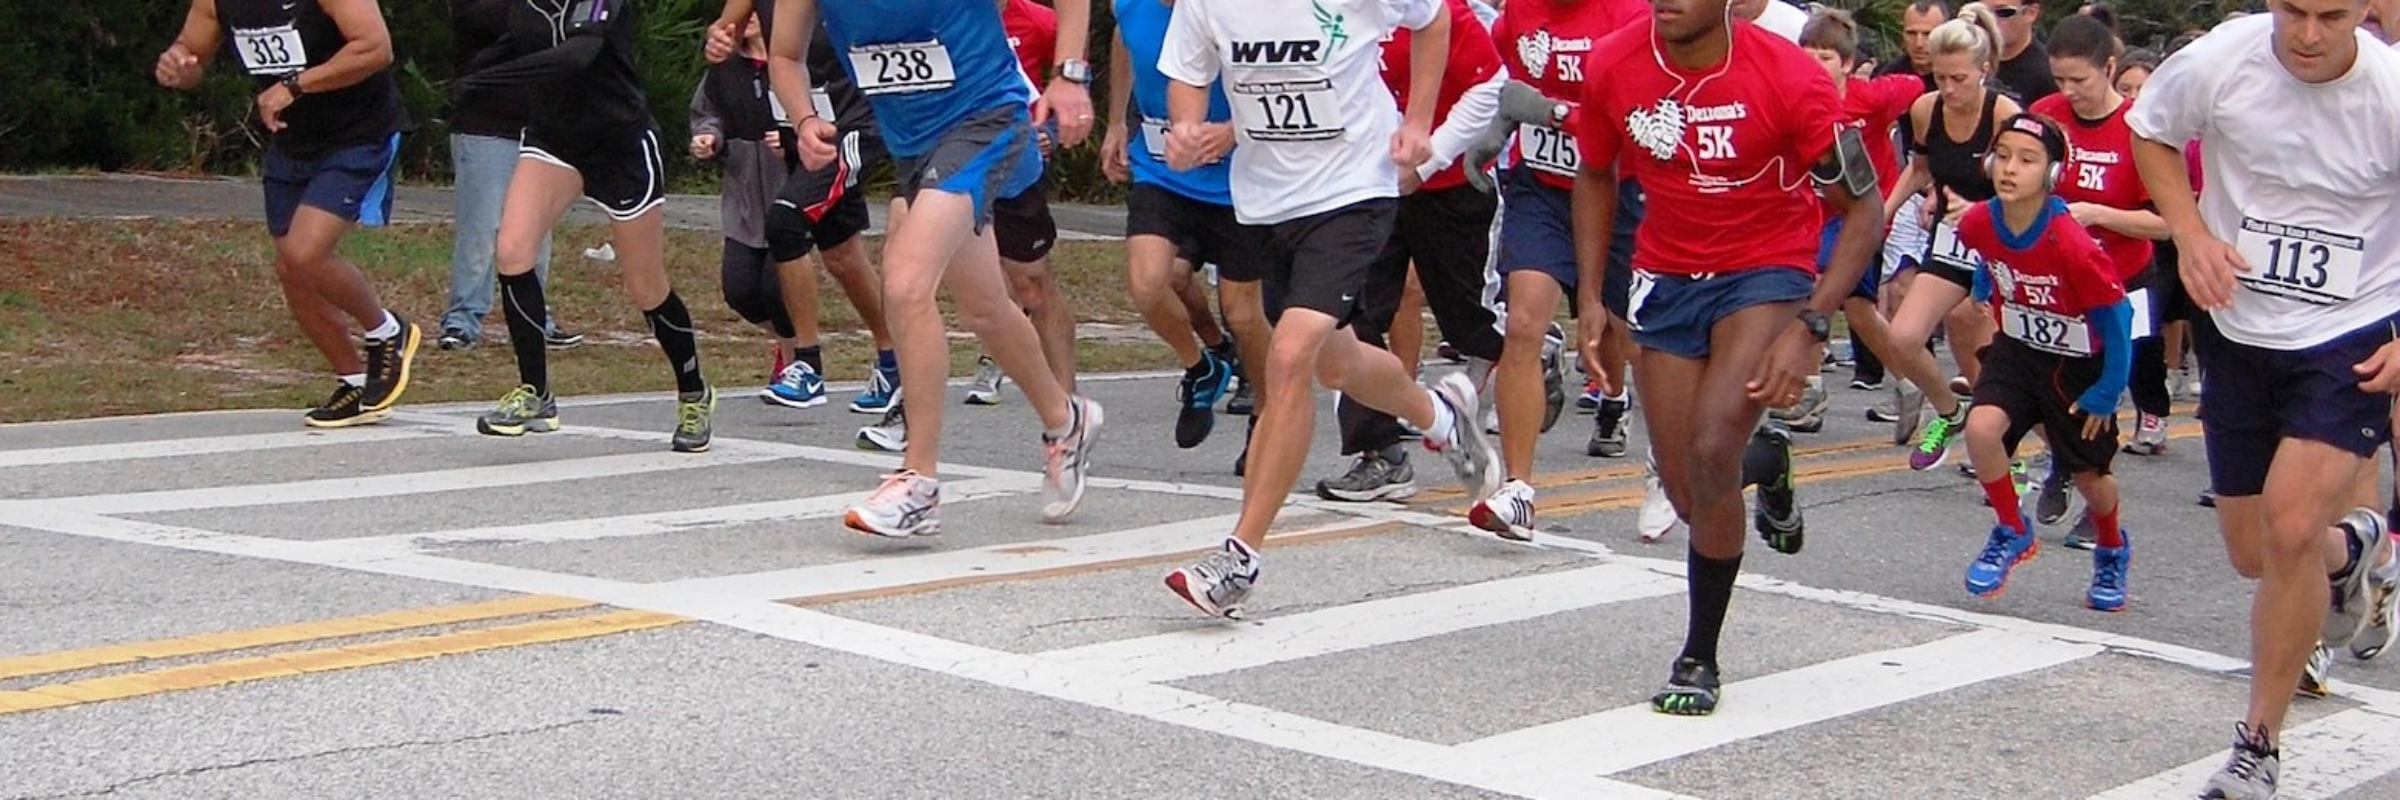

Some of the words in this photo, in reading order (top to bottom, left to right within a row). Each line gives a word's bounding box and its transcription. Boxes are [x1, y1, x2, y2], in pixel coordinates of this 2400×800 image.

[247, 34, 290, 65] 313
[871, 48, 933, 83] 238
[1231, 40, 1320, 63] WVR
[1556, 54, 1584, 81] 5K
[1257, 93, 1318, 129] 121
[1533, 127, 1576, 167] 275
[1696, 125, 1737, 159] 5K
[2077, 163, 2106, 191] 5K
[2262, 238, 2330, 289] 113
[2023, 284, 2057, 305] 5K
[2018, 313, 2070, 348] 182
